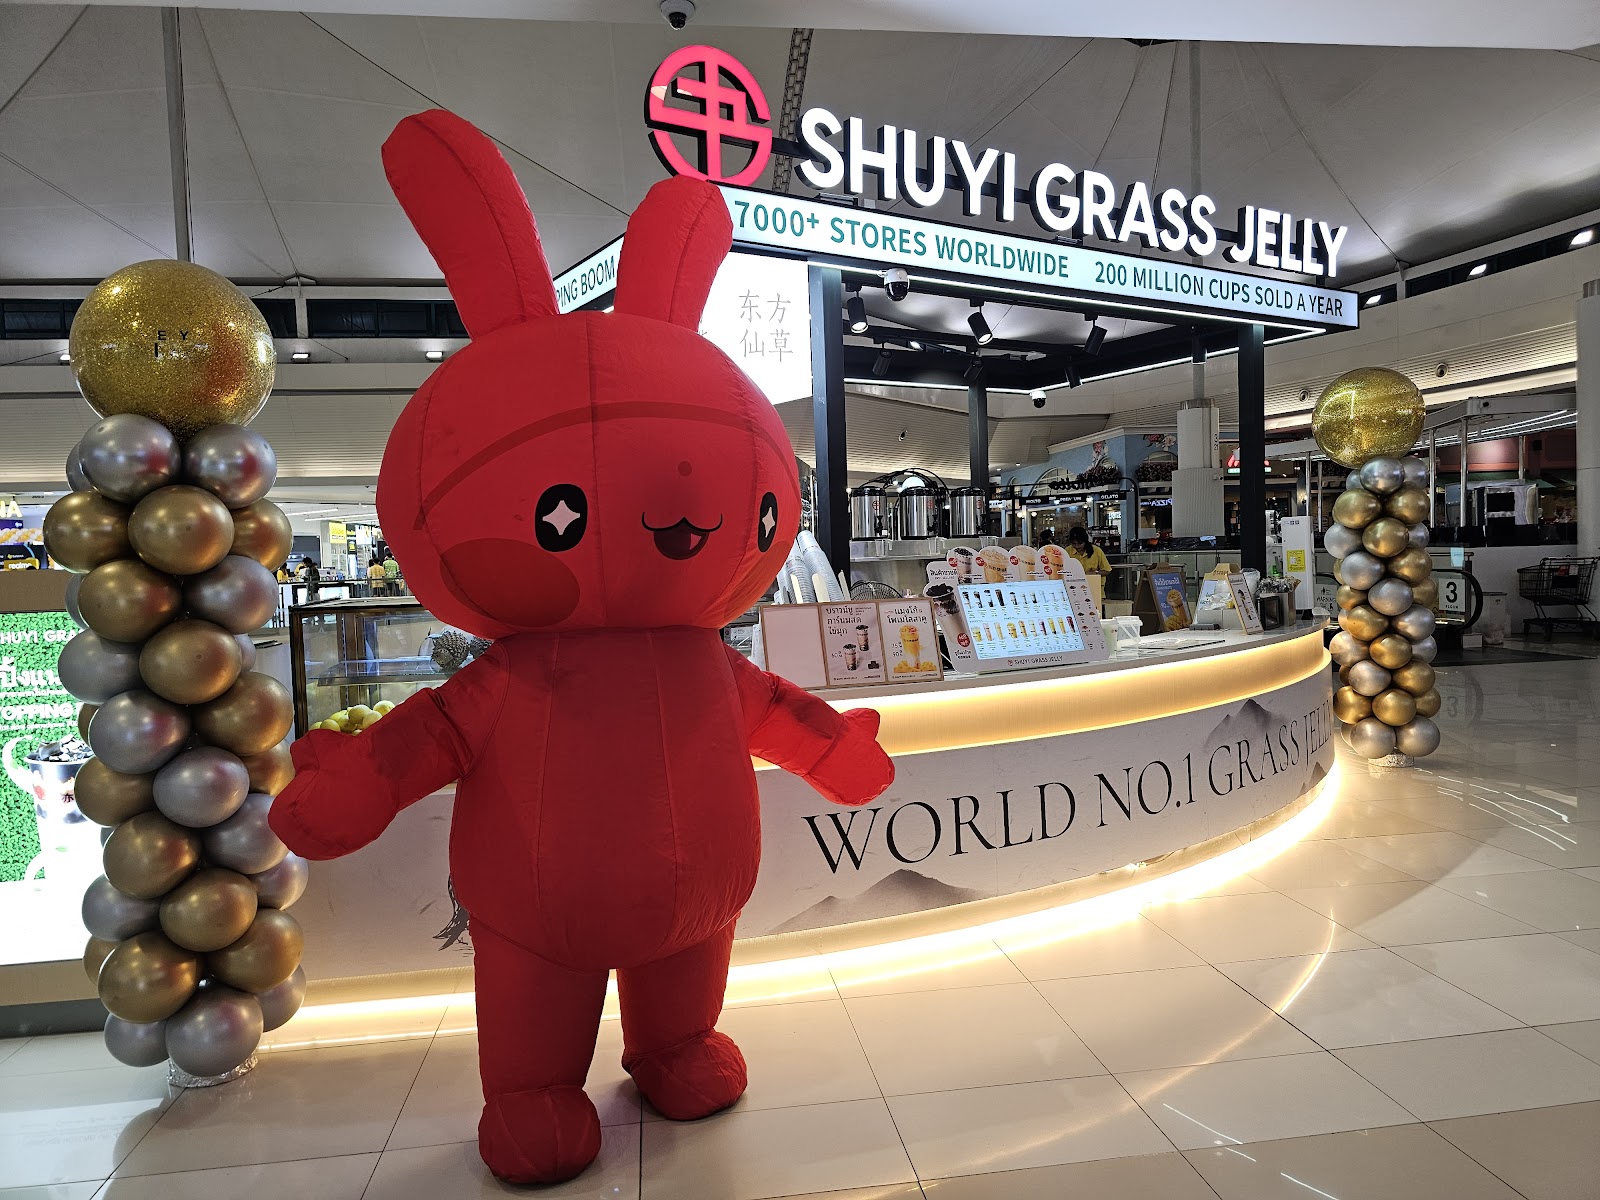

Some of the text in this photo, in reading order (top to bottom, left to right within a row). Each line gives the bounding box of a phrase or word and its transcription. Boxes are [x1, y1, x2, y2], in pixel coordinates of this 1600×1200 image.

[798, 107, 1348, 278] SHUYI GRASS JELLY
[581, 255, 615, 295] BOOM
[734, 200, 1343, 318] 7000+ STORES WORLDWIDE 200 MILLION CUPS SOLD A YEAR
[739, 288, 791, 323] 东方
[740, 329, 793, 362] 仙草
[1446, 582, 1458, 603] 3
[43, 629, 85, 643] GRA
[801, 781, 1076, 875] WORLD
[1094, 753, 1197, 827] NO.1
[1208, 719, 1300, 798] GRASS
